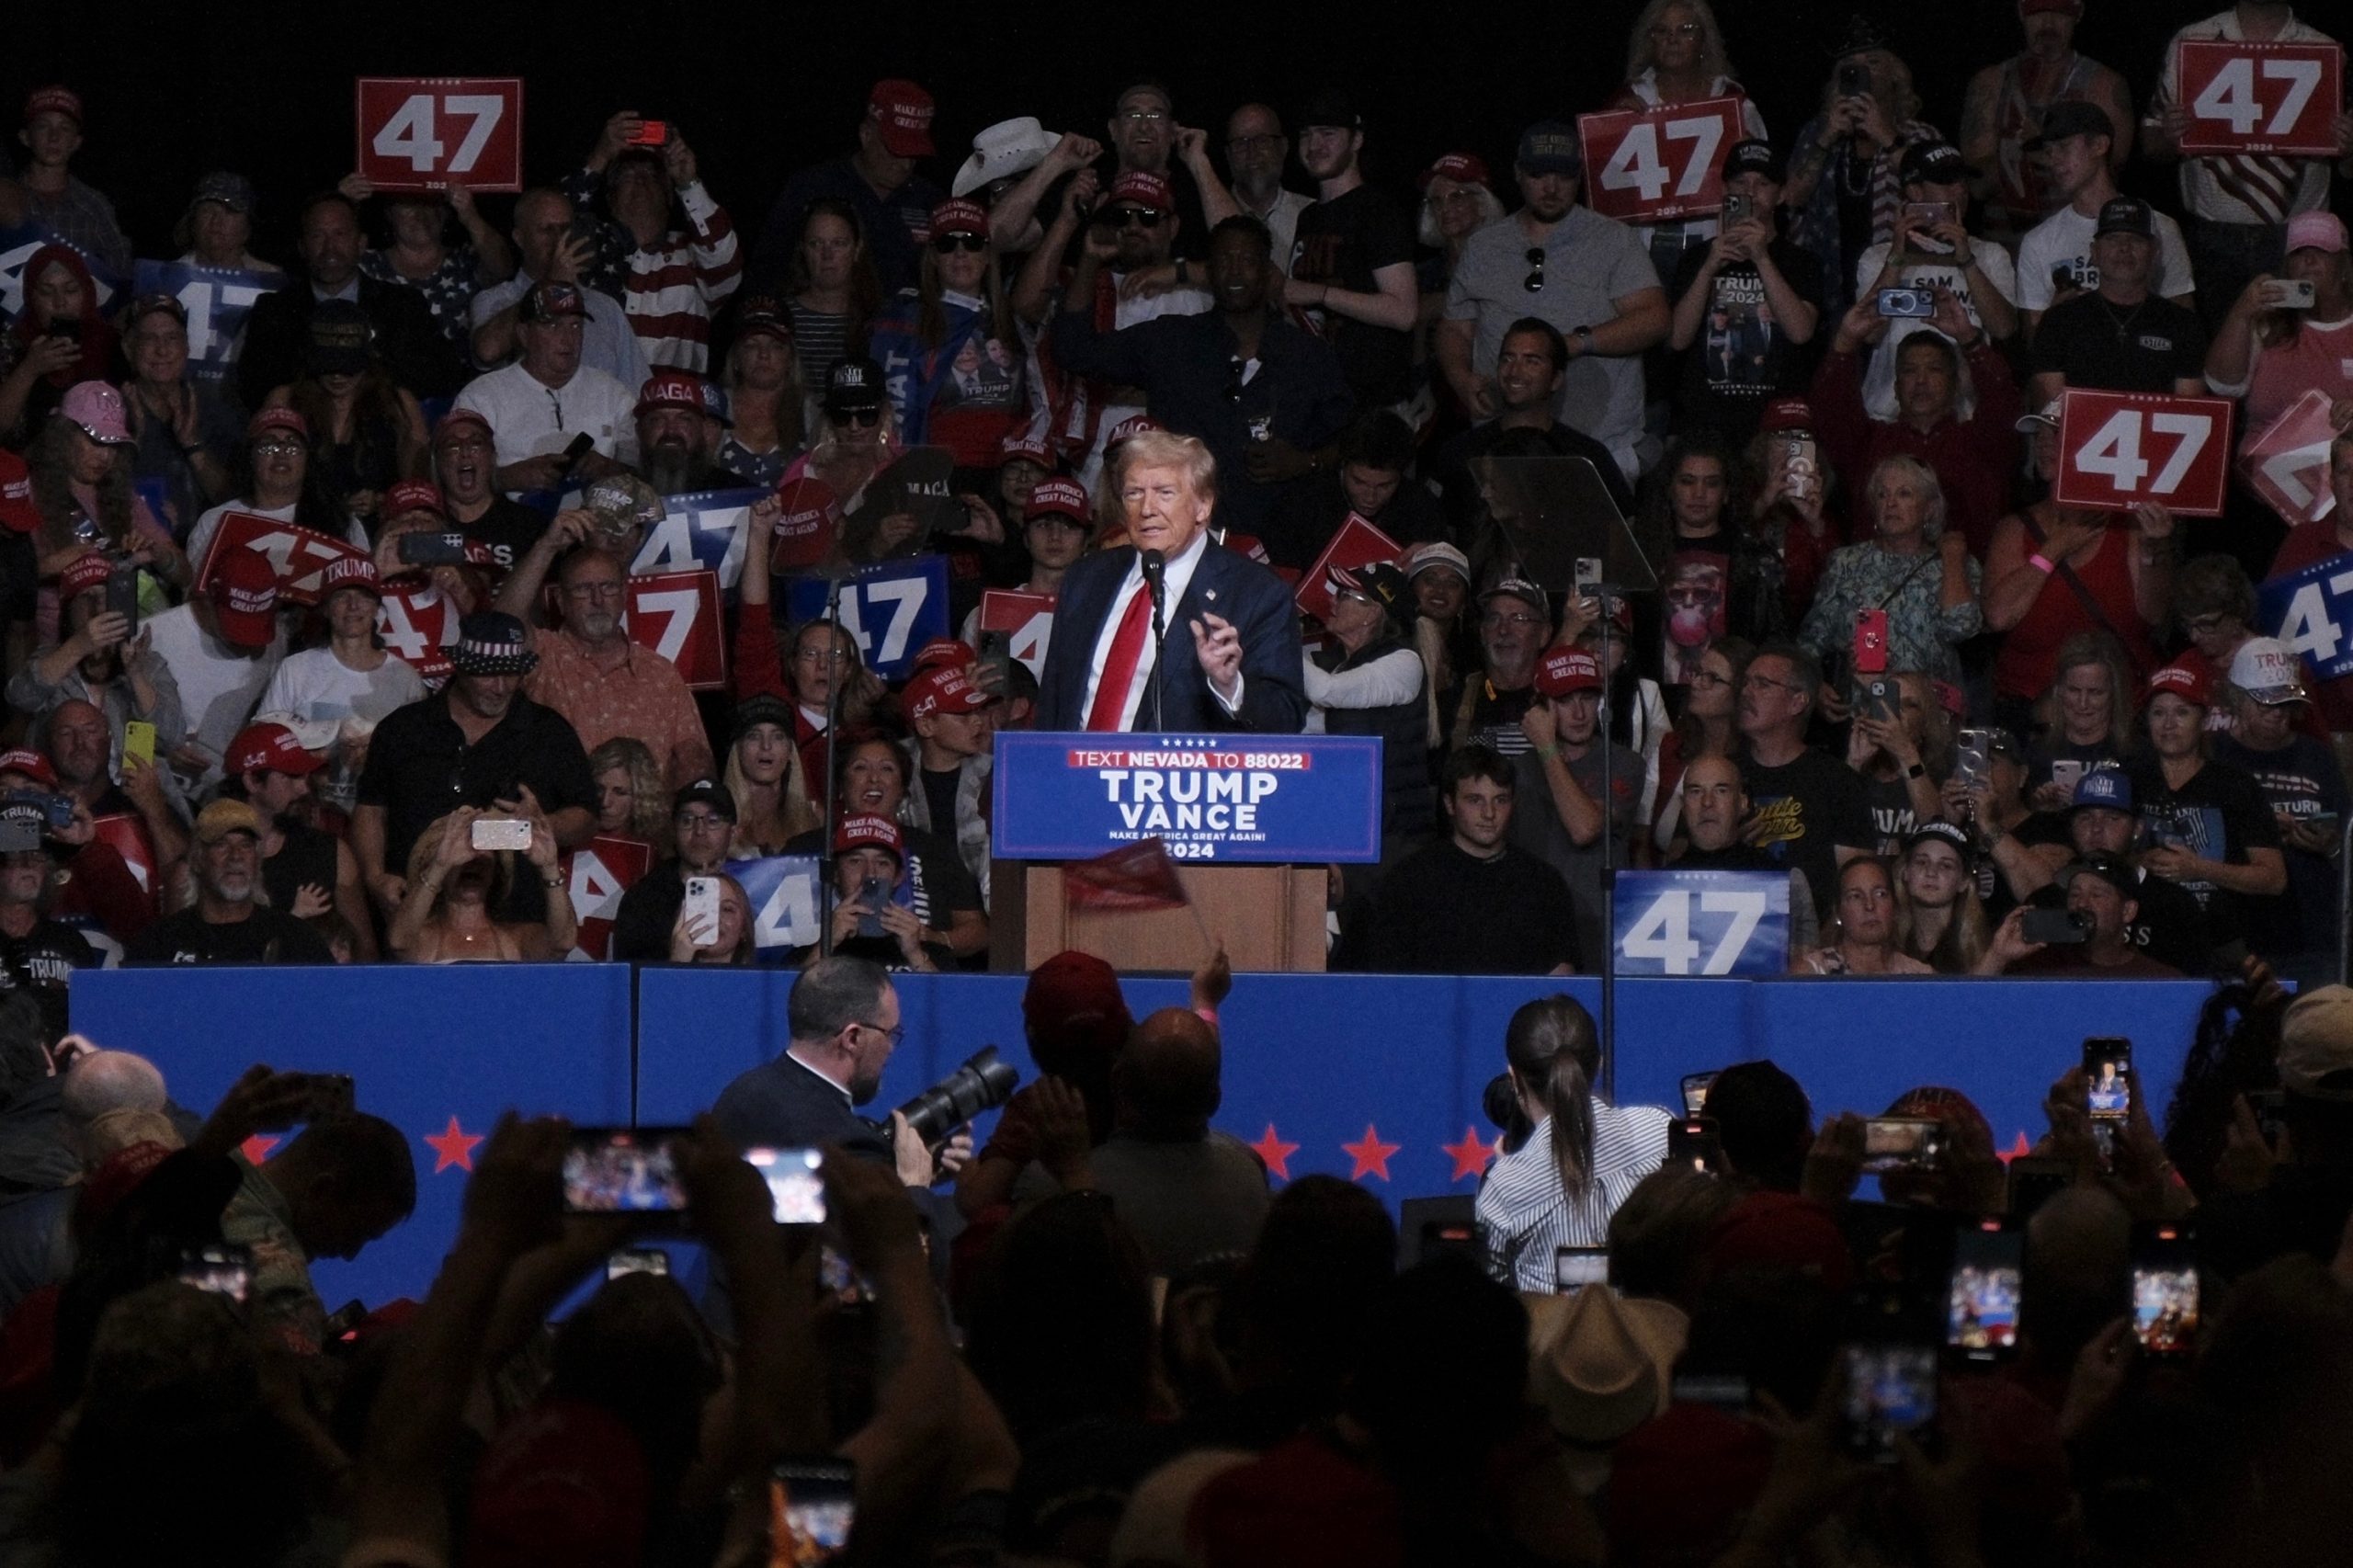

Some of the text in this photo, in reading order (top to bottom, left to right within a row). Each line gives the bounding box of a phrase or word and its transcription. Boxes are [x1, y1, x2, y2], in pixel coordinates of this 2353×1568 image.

[2193, 57, 2323, 135] 47
[371, 94, 504, 172] 47
[1599, 115, 1725, 200] 47
[1655, 205, 1684, 217] 2024
[1714, 278, 1762, 291] TRUM
[1913, 276, 1951, 288] SAM
[642, 382, 695, 403] MAGA
[967, 383, 1008, 396] TRUMP
[2075, 409, 2213, 494] 47
[1054, 483, 1083, 499] AMERICA
[1035, 493, 1080, 508] GREAT AGAIN
[324, 560, 374, 584] TRUMP
[378, 595, 461, 659] 47
[1009, 612, 1055, 689] 4
[424, 661, 451, 673] 2024
[1545, 657, 1569, 670] MAKE
[1552, 665, 1576, 679] GREAT
[1074, 751, 1303, 769] TEXT NEVADA TO 88022
[1099, 770, 1279, 804] TRUMP
[0, 805, 45, 821] TRUMP
[2270, 800, 2321, 814] ETURN
[1119, 803, 1257, 831] VANCE
[844, 817, 898, 837] MAKE AMERICA
[847, 827, 894, 844] GREAT AGAIN
[1109, 831, 1266, 842] MAKE AMERICA GREAT AGAIN!
[754, 873, 823, 948] 4
[1621, 889, 1767, 976] 47
